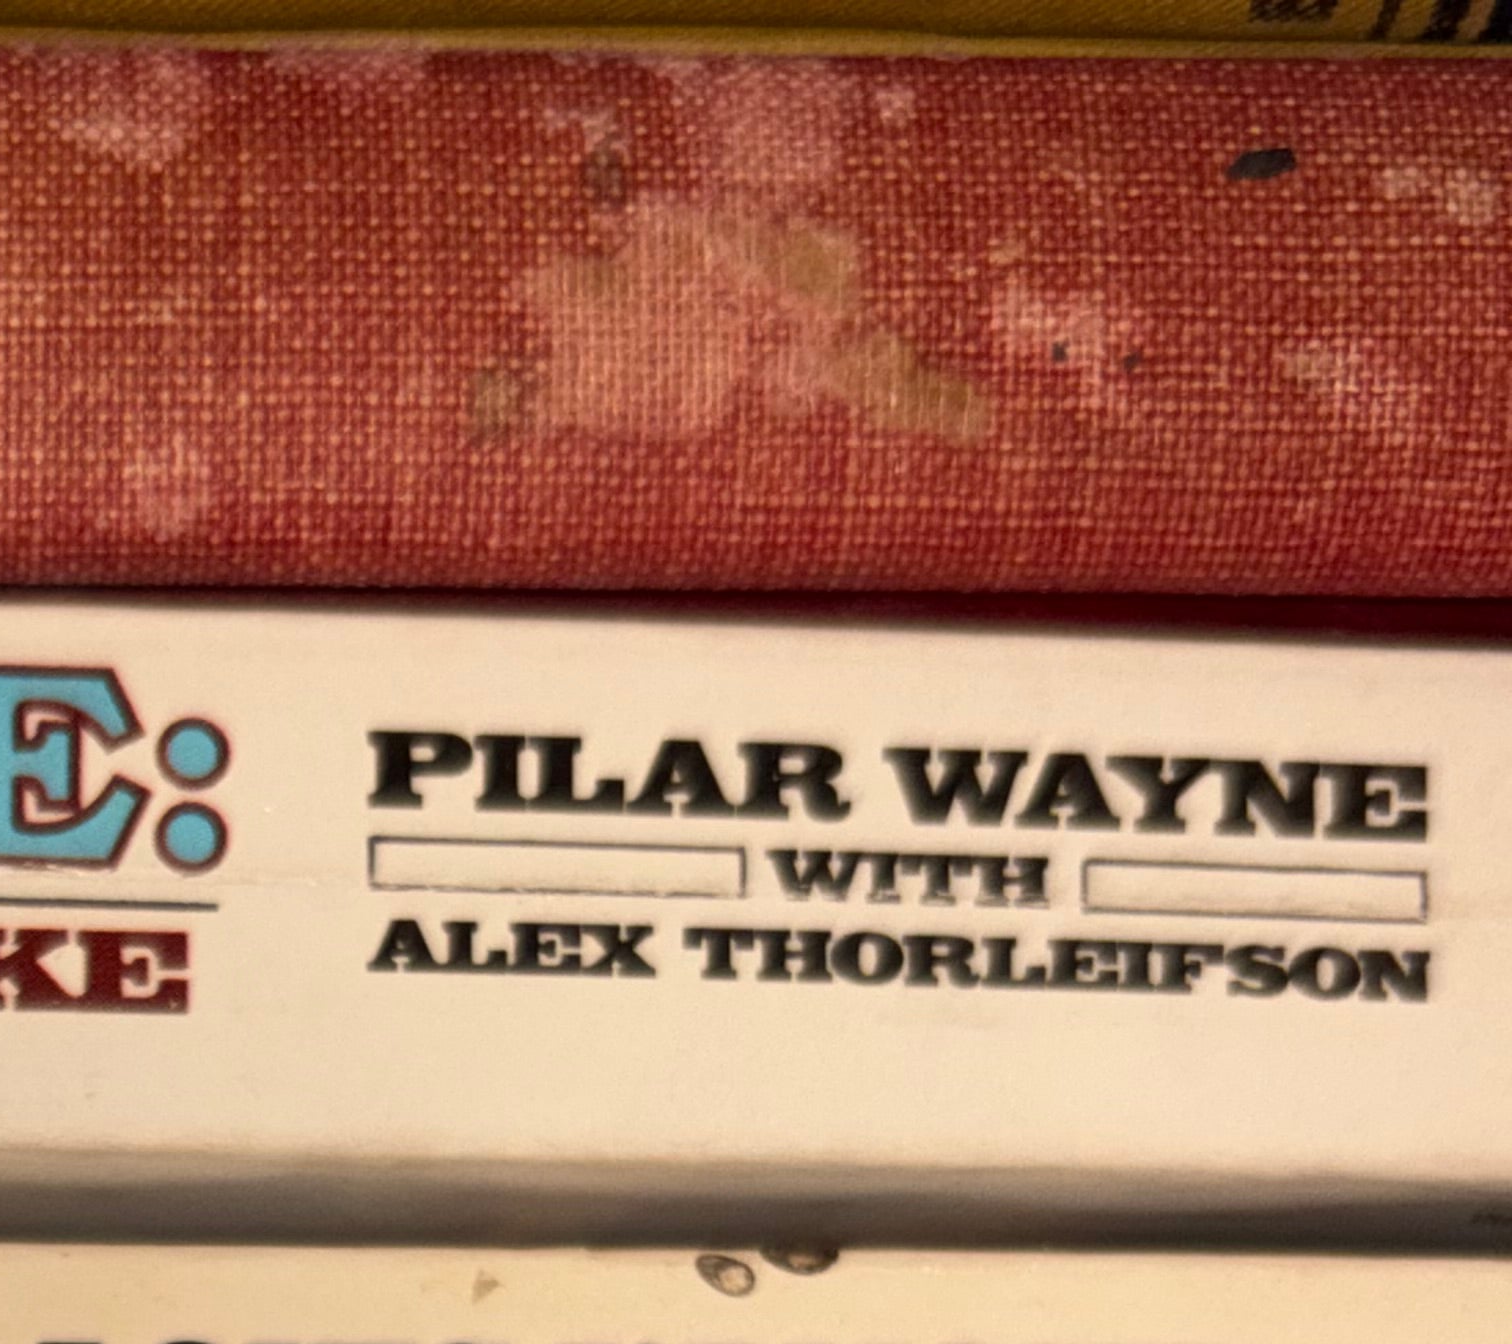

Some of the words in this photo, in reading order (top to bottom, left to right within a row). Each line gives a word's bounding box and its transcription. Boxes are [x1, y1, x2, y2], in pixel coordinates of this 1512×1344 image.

[367, 728, 852, 824] PILAR
[882, 745, 1431, 843] WAYNE
[765, 846, 1051, 908] WITH
[367, 917, 657, 979] ALEX
[682, 923, 1434, 1004] THORLEIFSON
